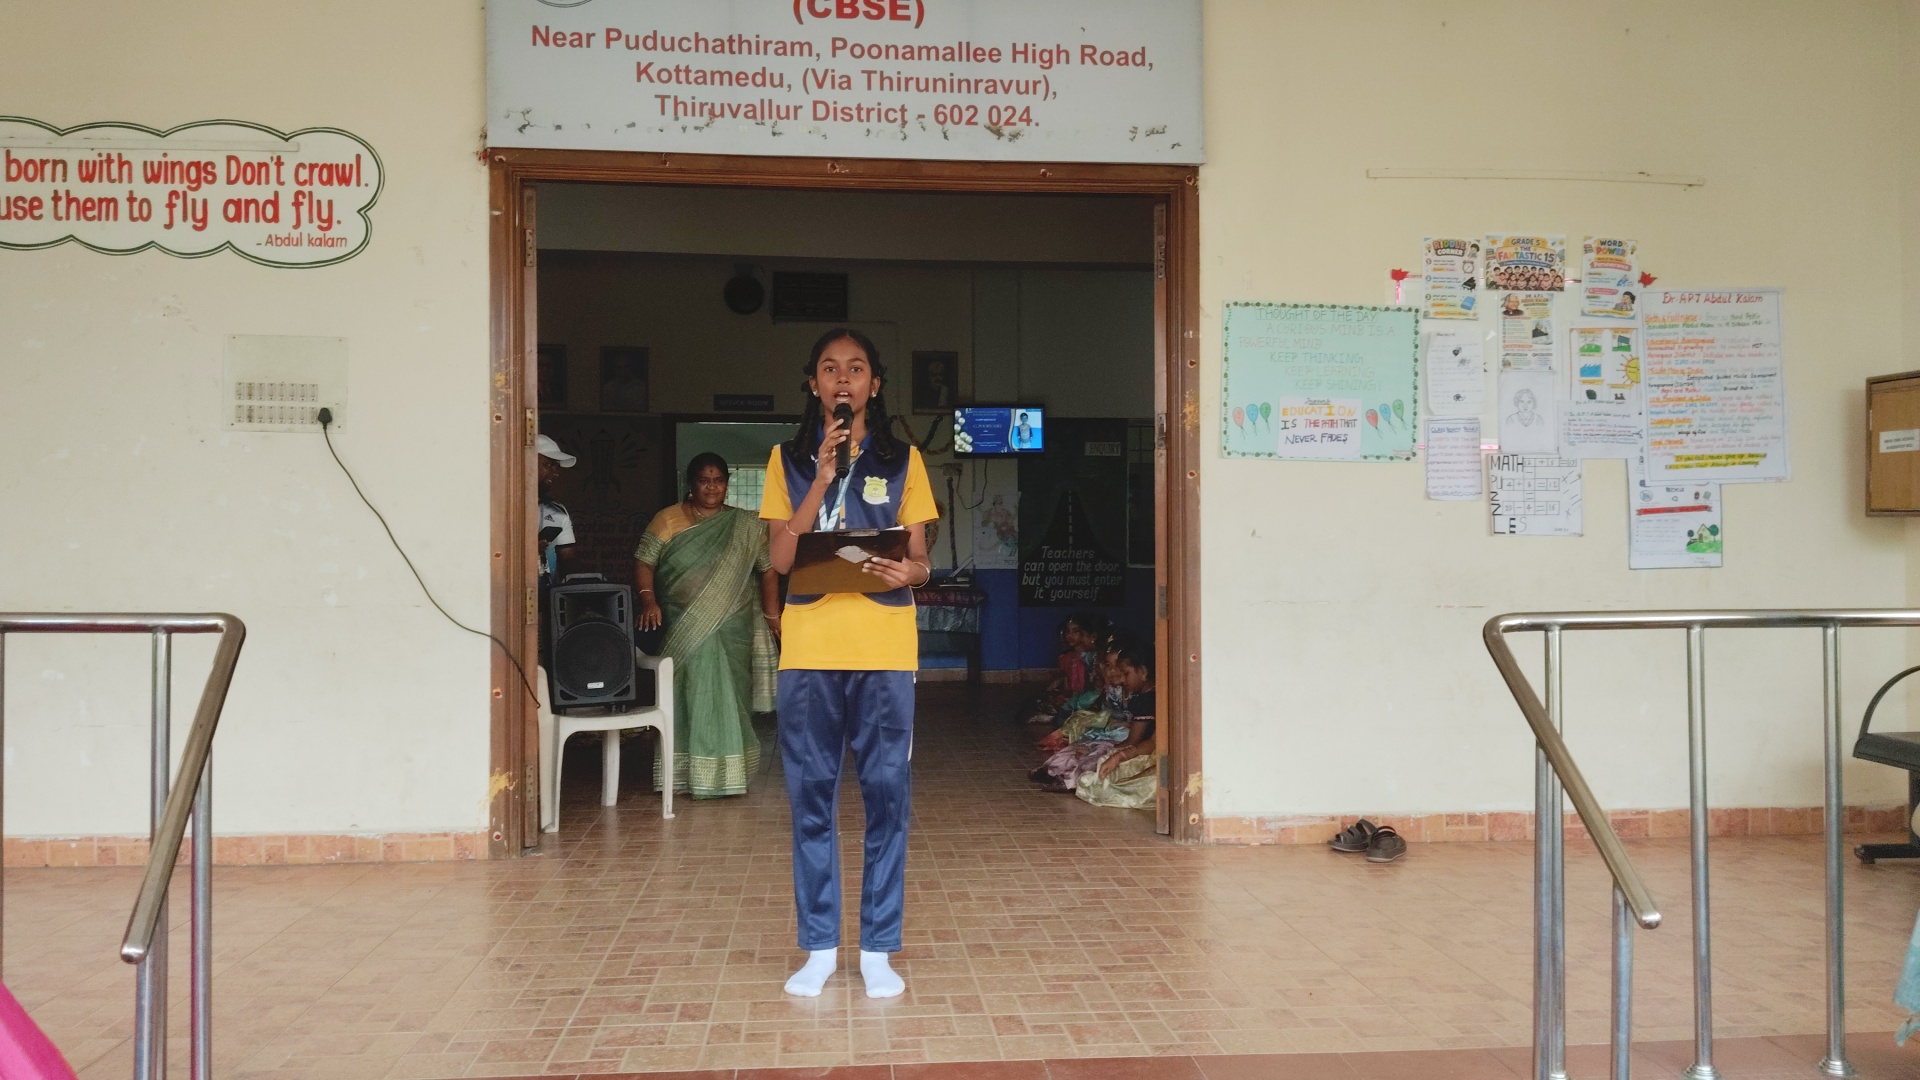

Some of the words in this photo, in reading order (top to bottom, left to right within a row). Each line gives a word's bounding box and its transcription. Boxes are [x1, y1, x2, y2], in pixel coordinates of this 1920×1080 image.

[793, 0, 925, 28] (CBSE)
[531, 25, 596, 48] Near
[605, 28, 821, 60] Puduchathiram,
[831, 37, 1002, 63] Poonamallee
[1011, 43, 1070, 70] High
[1080, 45, 1154, 71] Road,
[636, 62, 792, 92] Kottamedu,
[802, 67, 852, 95] (Via
[861, 70, 1058, 101] Thiruninravur),
[655, 94, 803, 121] Thiruvallur
[812, 100, 907, 125] District
[934, 104, 979, 126] 602
[988, 104, 1040, 127] 024.
[5, 150, 68, 183] born
[78, 153, 133, 184] with
[143, 153, 218, 192] wings
[225, 155, 285, 187] Don't
[294, 154, 369, 187] crawl.
[52, 190, 119, 222] them
[127, 191, 153, 222] to
[164, 190, 209, 232] fly
[222, 191, 280, 224] and
[291, 191, 342, 232] fly.
[307, 233, 348, 248] kalam
[1432, 240, 1467, 250] RIDDLE
[1497, 251, 1543, 261] FANTASTIC
[1544, 252, 1555, 263] 15
[1596, 247, 1626, 256] POWER
[1704, 292, 1731, 304] Abdul
[1736, 292, 1763, 304] Kalam
[1257, 308, 1309, 320] THOUGHT
[1313, 310, 1326, 320] OF
[1330, 310, 1353, 321] THE
[1356, 311, 1378, 322] DAY
[1266, 323, 1274, 334] A
[1369, 325, 1384, 336] IS
[1386, 325, 1395, 336] A
[1270, 352, 1298, 363] KEEP
[1303, 352, 1364, 364] THINKING
[1281, 405, 1356, 417] EDUCATION
[1281, 419, 1297, 430] IS
[1304, 419, 1320, 428] THE
[1339, 419, 1358, 428] THAT
[1285, 434, 1317, 445] NEVER
[1490, 455, 1524, 473] MATH
[1041, 545, 1095, 559] Teachers
[1024, 562, 1045, 572] can
[1048, 562, 1073, 574] open
[1076, 560, 1092, 572] the
[1022, 573, 1041, 586] but
[1044, 575, 1064, 588] you
[1066, 574, 1091, 586] must
[1094, 574, 1123, 586] enter
[1034, 586, 1045, 599] it
